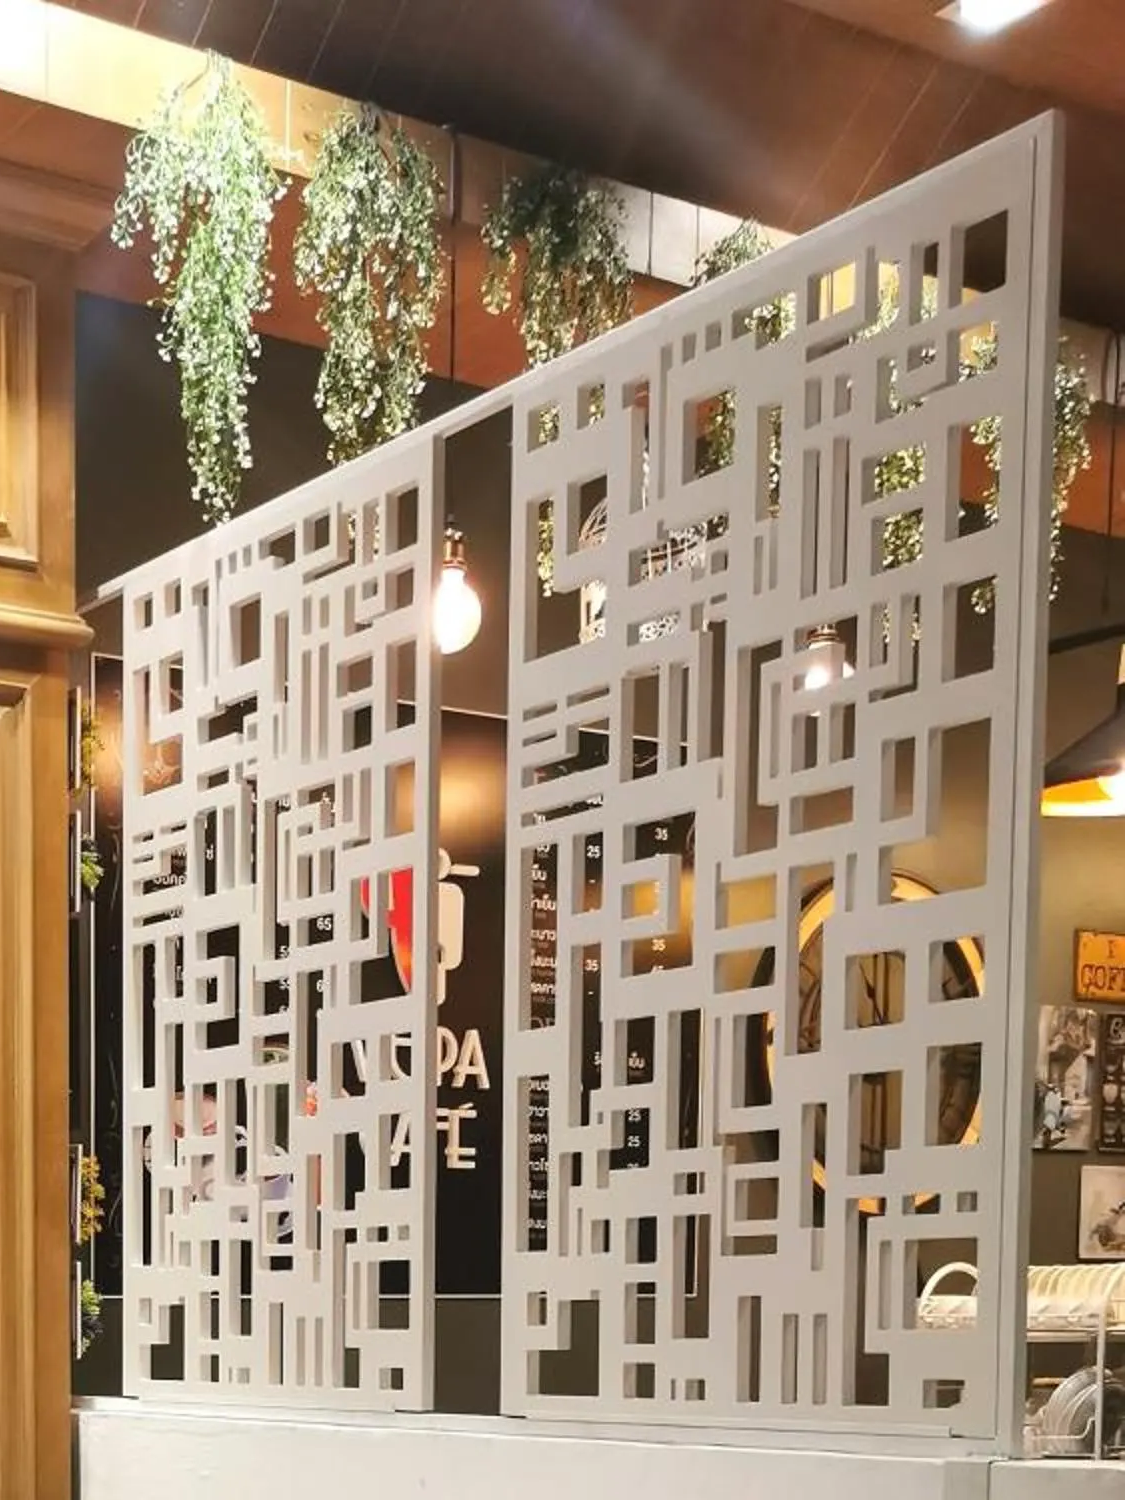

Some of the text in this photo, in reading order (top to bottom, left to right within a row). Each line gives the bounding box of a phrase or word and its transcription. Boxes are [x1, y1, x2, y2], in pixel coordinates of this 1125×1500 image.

[586, 845, 601, 859] 25
[316, 917, 332, 931] 65
[584, 958, 599, 972] 35
[1081, 963, 1125, 993] COF
[627, 1135, 641, 1148] 25
